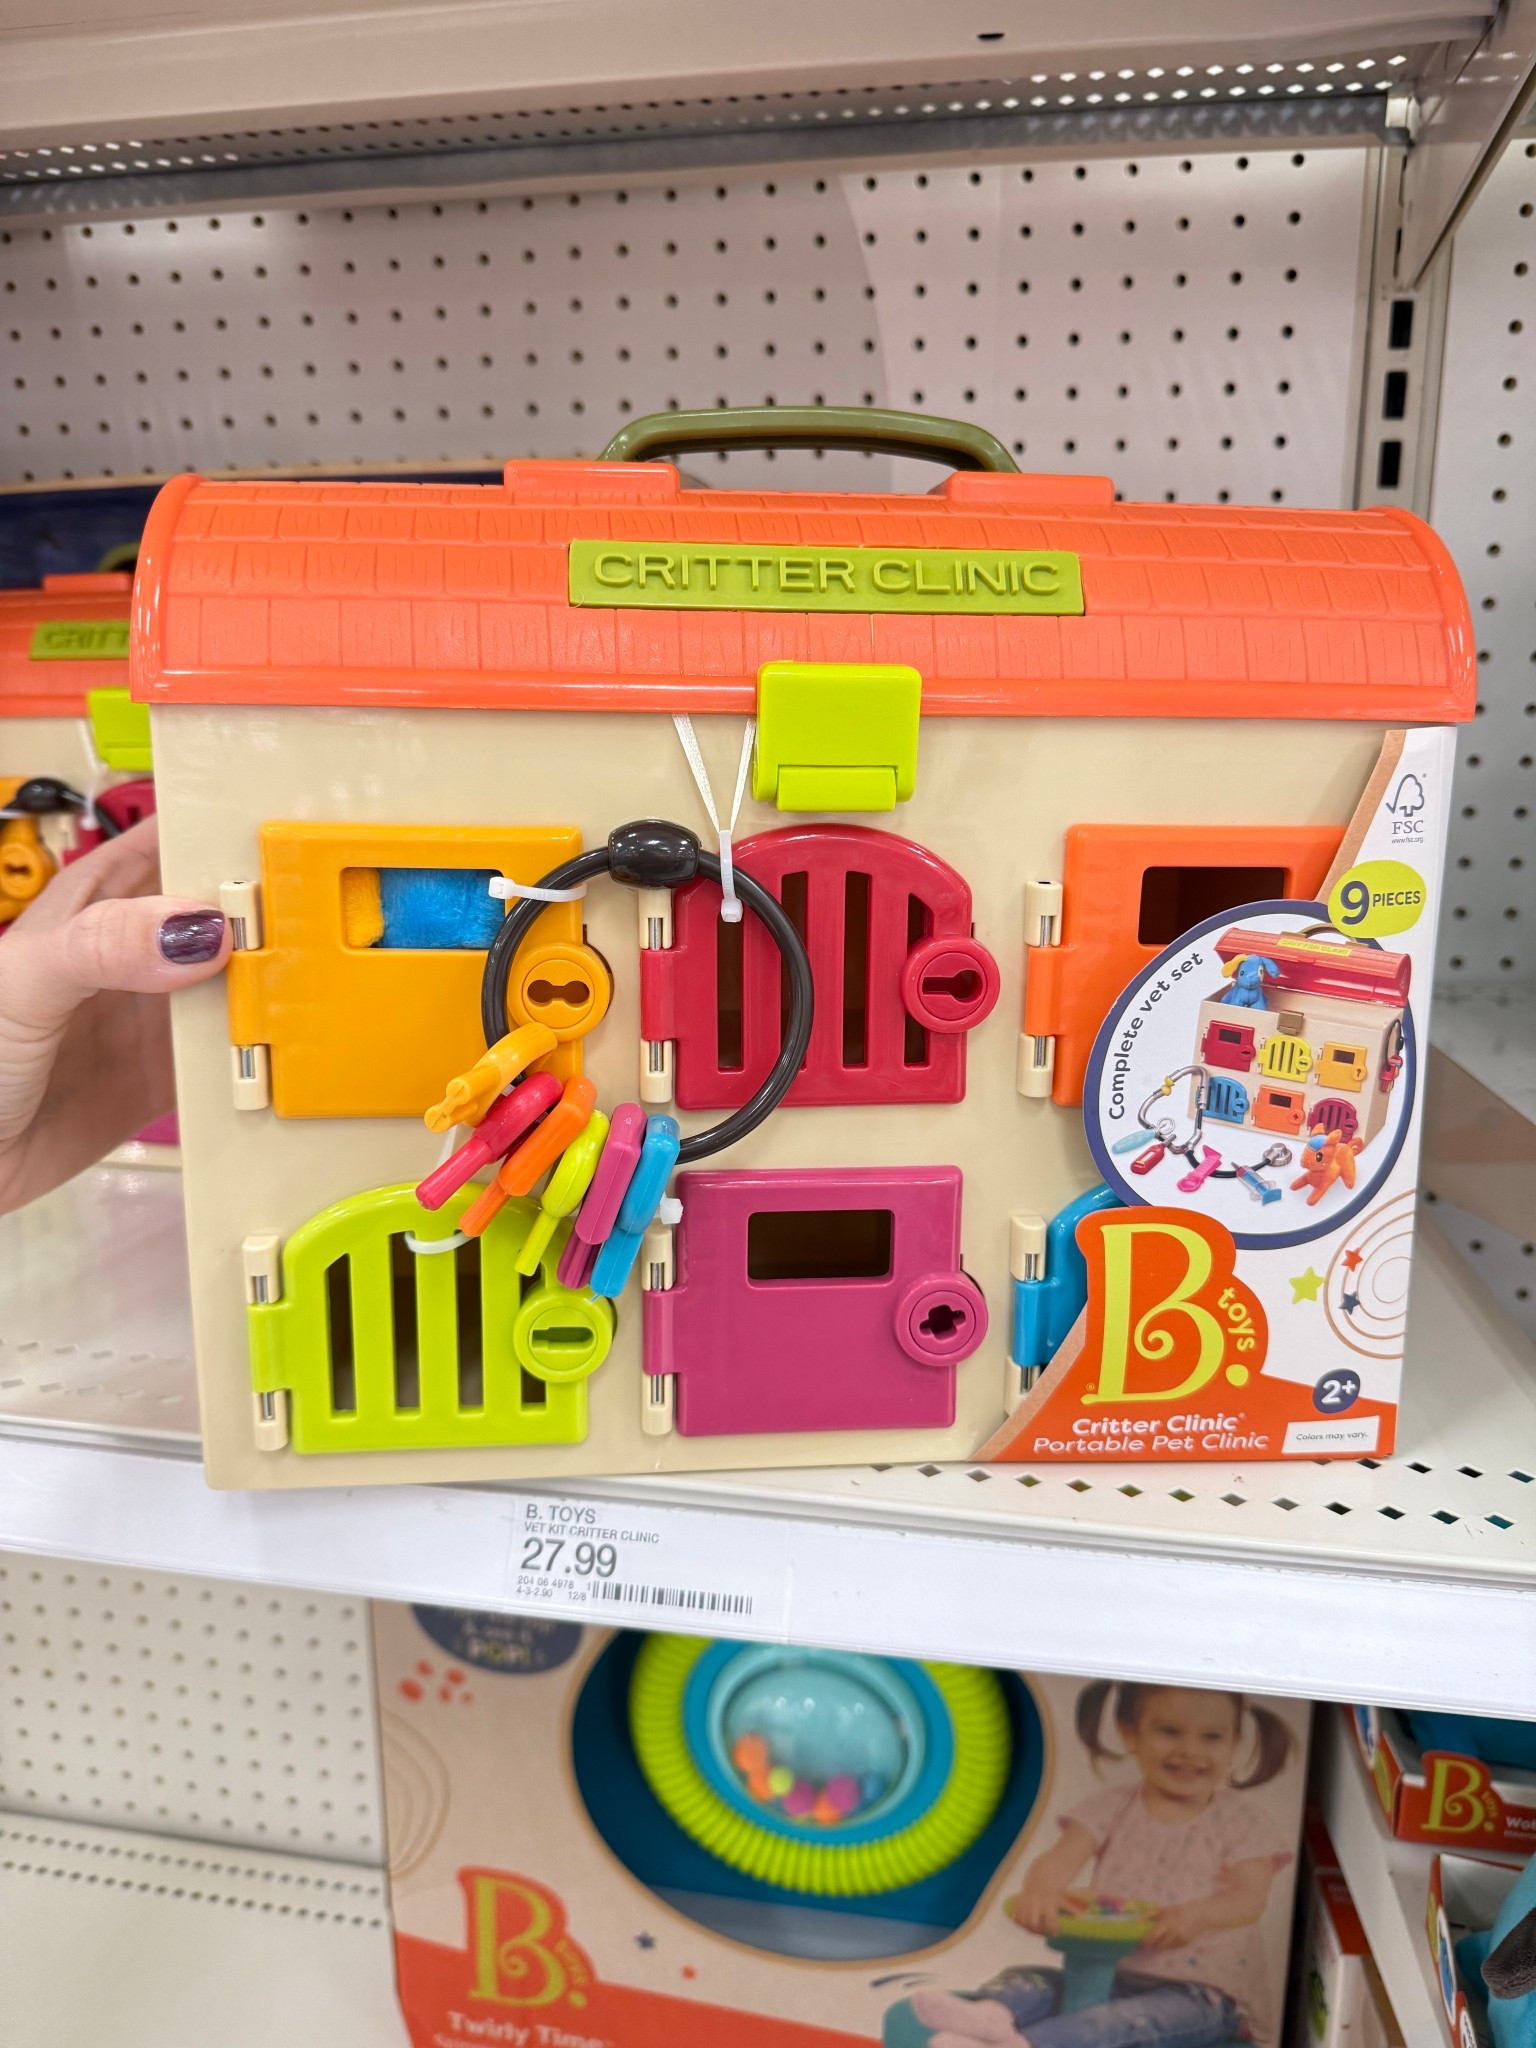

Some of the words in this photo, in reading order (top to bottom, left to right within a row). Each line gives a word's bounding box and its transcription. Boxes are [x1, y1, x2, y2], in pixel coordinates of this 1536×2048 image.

[593, 552, 856, 594] CRITTER
[872, 558, 1062, 597] CLINIC
[1391, 820, 1424, 835] FSC
[1391, 836, 1424, 844] www.fsc.org
[1340, 880, 1370, 926] 9
[1372, 890, 1421, 907] PIECES
[1108, 1017, 1144, 1120] Complete
[1139, 979, 1170, 1013] vet
[1170, 952, 1204, 982] set
[1217, 1286, 1255, 1352] toys
[1321, 1379, 1356, 1405] 2+
[1072, 1417, 1160, 1435] Critter
[1296, 1433, 1324, 1441] Colors
[1325, 1433, 1345, 1441] may
[1347, 1431, 1368, 1440] vary.
[1033, 1436, 1144, 1453] Portable
[1152, 1435, 1195, 1451] Pet
[1202, 1432, 1269, 1450] Clinic
[525, 1503, 543, 1520] B.
[549, 1505, 597, 1524] TOYS
[524, 1521, 547, 1533] VET
[548, 1523, 568, 1535] KIT
[569, 1525, 618, 1540] CRITTER
[620, 1530, 660, 1544] CLINIC
[520, 1536, 618, 1578] 27.99
[517, 1575, 535, 1585] 204
[537, 1577, 549, 1586] 06
[551, 1579, 575, 1589] 4978
